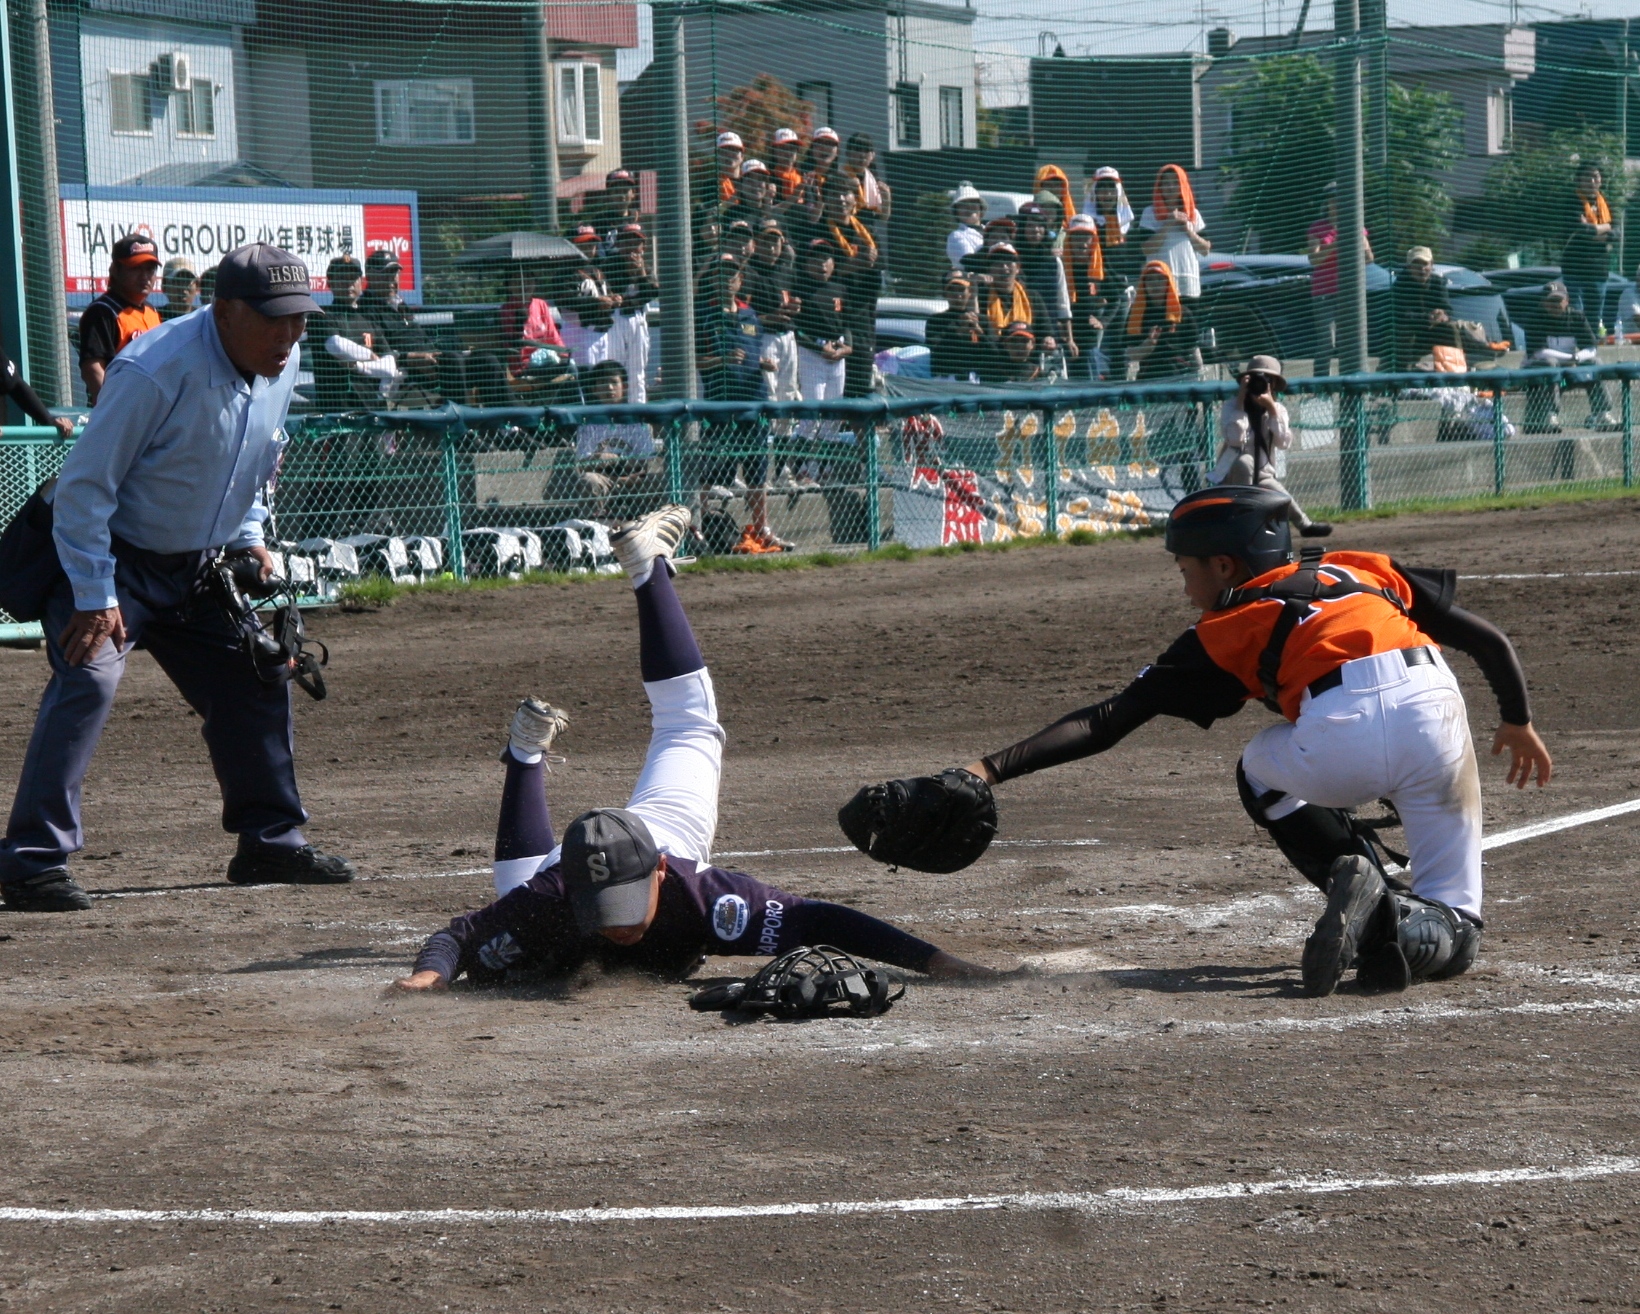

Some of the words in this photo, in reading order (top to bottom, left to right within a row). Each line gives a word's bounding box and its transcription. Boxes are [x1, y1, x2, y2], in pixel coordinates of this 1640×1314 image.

[163, 224, 246, 255] GROUP
[587, 851, 610, 882] S
[755, 900, 784, 956] APPORO
